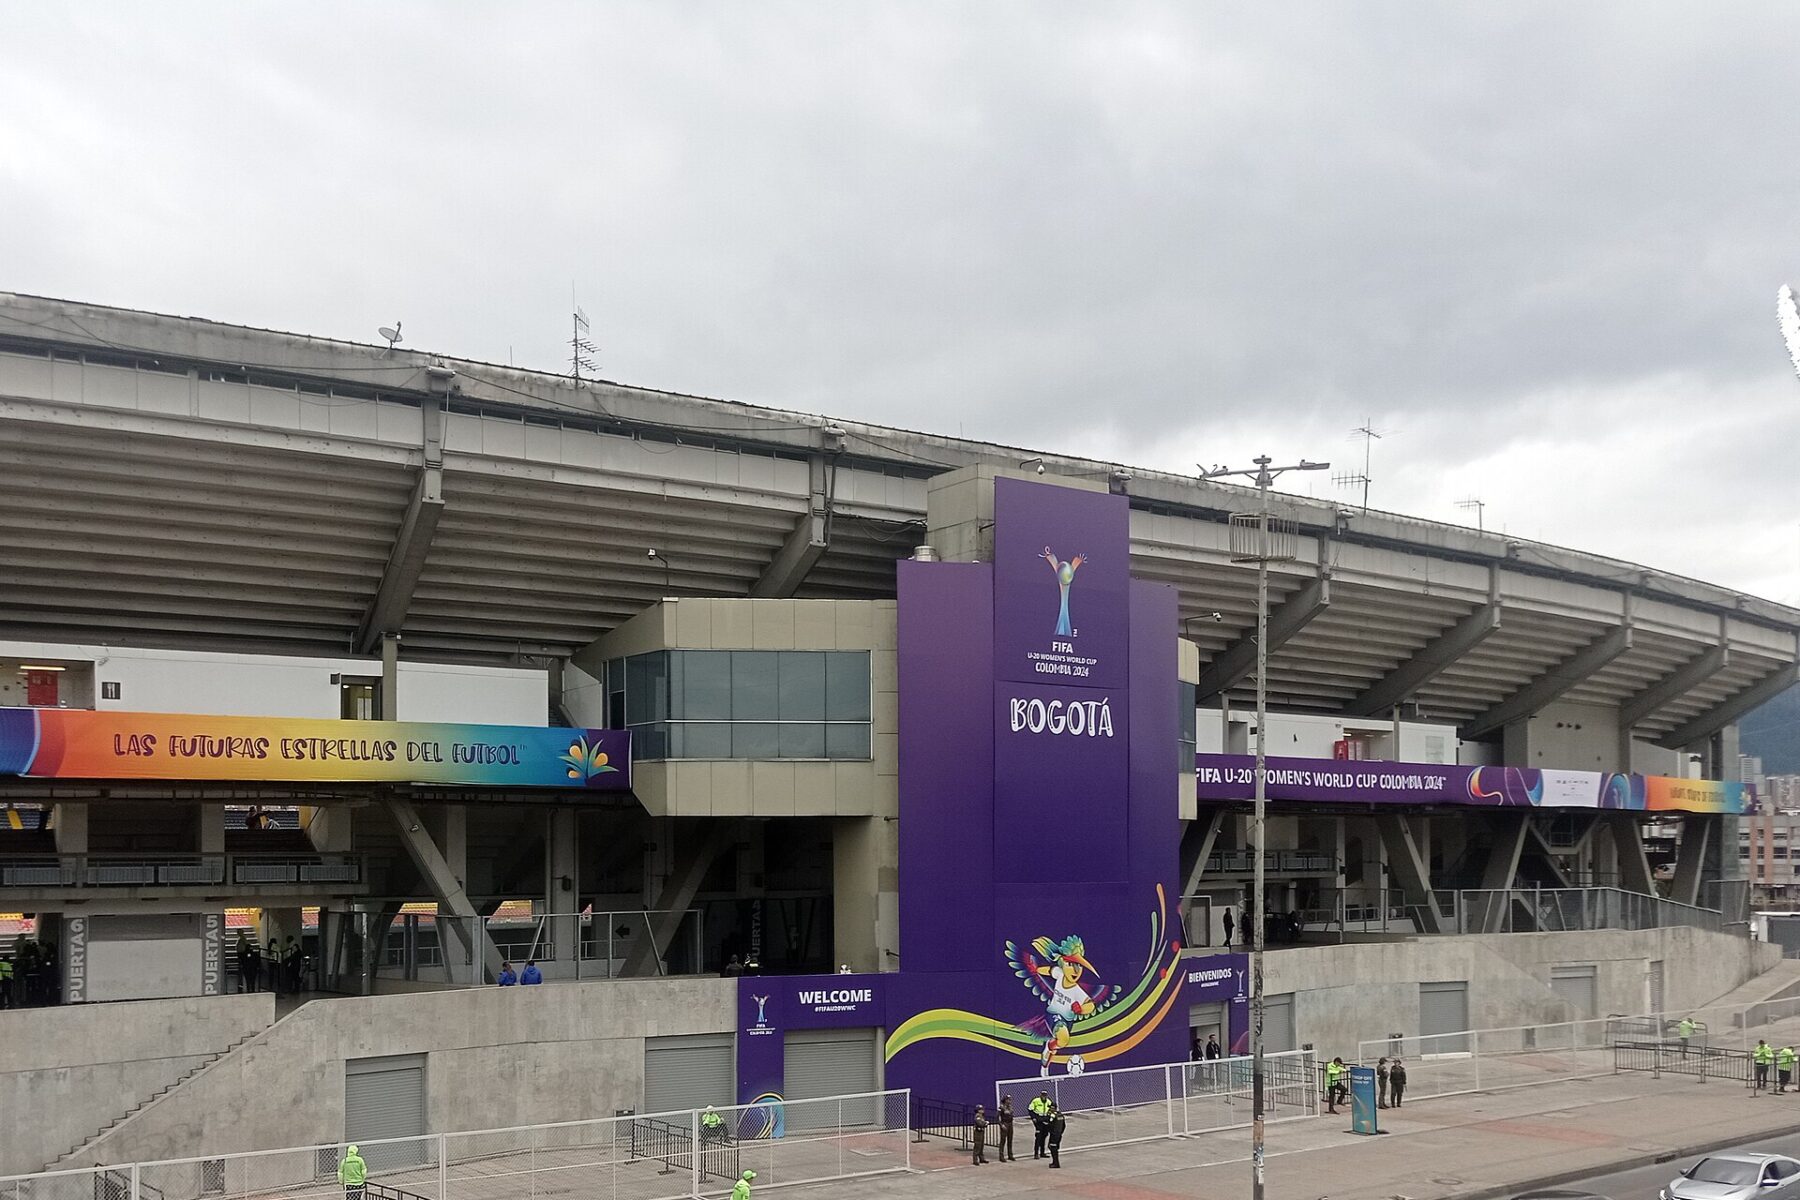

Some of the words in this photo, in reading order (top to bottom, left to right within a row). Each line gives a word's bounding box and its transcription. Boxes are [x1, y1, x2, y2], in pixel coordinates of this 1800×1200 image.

[1052, 641, 1073, 654] FIFA
[1027, 652, 1040, 660] U-20
[1040, 653, 1066, 663] WOMEN'S
[1066, 655, 1086, 665] WORLD
[1035, 662, 1071, 676] COLOMBIA
[1073, 666, 1089, 677] 2024
[1010, 697, 1114, 737] BOGOTÁ
[114, 733, 157, 757] LAS
[168, 735, 270, 760] FUTURAS
[281, 738, 397, 762] ESTRELLAS
[406, 741, 443, 763] DEL
[1195, 767, 1222, 783] FIFA
[1224, 768, 1252, 784] U-20
[1313, 772, 1354, 788] WORLD
[1356, 773, 1377, 788] CUP
[1380, 774, 1422, 790] COLOMBIA
[1188, 968, 1232, 983] BIENVENIDOS
[799, 989, 872, 1004] WELCOME
